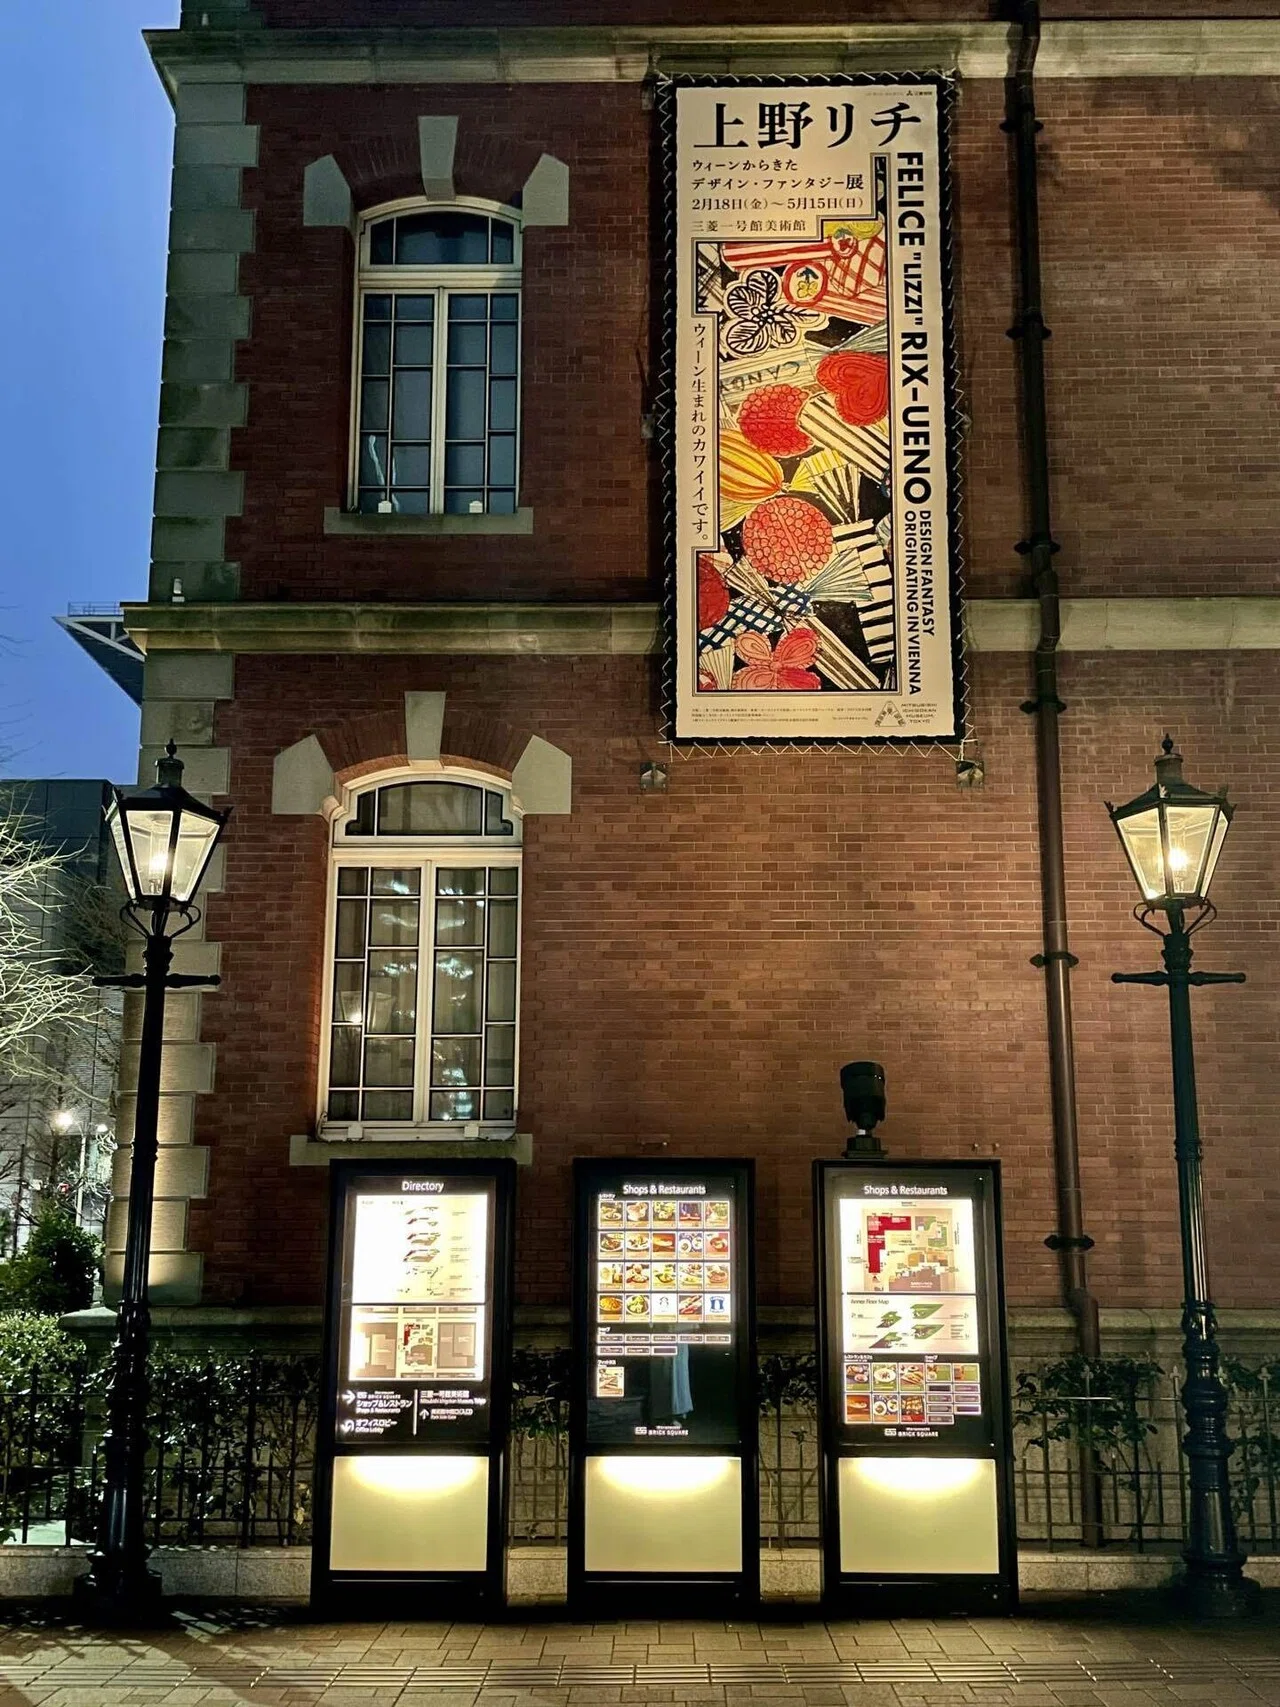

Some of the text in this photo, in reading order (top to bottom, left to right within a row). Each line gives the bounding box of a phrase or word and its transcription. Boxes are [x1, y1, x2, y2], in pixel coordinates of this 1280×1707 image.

[694, 101, 922, 149] 上野リチ
[692, 159, 798, 172] ウィーンからきた
[692, 174, 864, 190] デザイン・ファンタジー展
[692, 220, 806, 232] 三菱一号館美術館
[897, 152, 932, 504] FELICE "LIZZI" RIX-UENO
[692, 323, 708, 540] ウィーン生まれのカワイイです。
[920, 510, 934, 636] DESIGN FANTASY
[904, 510, 921, 695] ORIGINATING IN VIENNA
[402, 1180, 444, 1193] Directory
[623, 1184, 706, 1196] Shops & Restaurants
[864, 1185, 948, 1196] Shops & Restaurants
